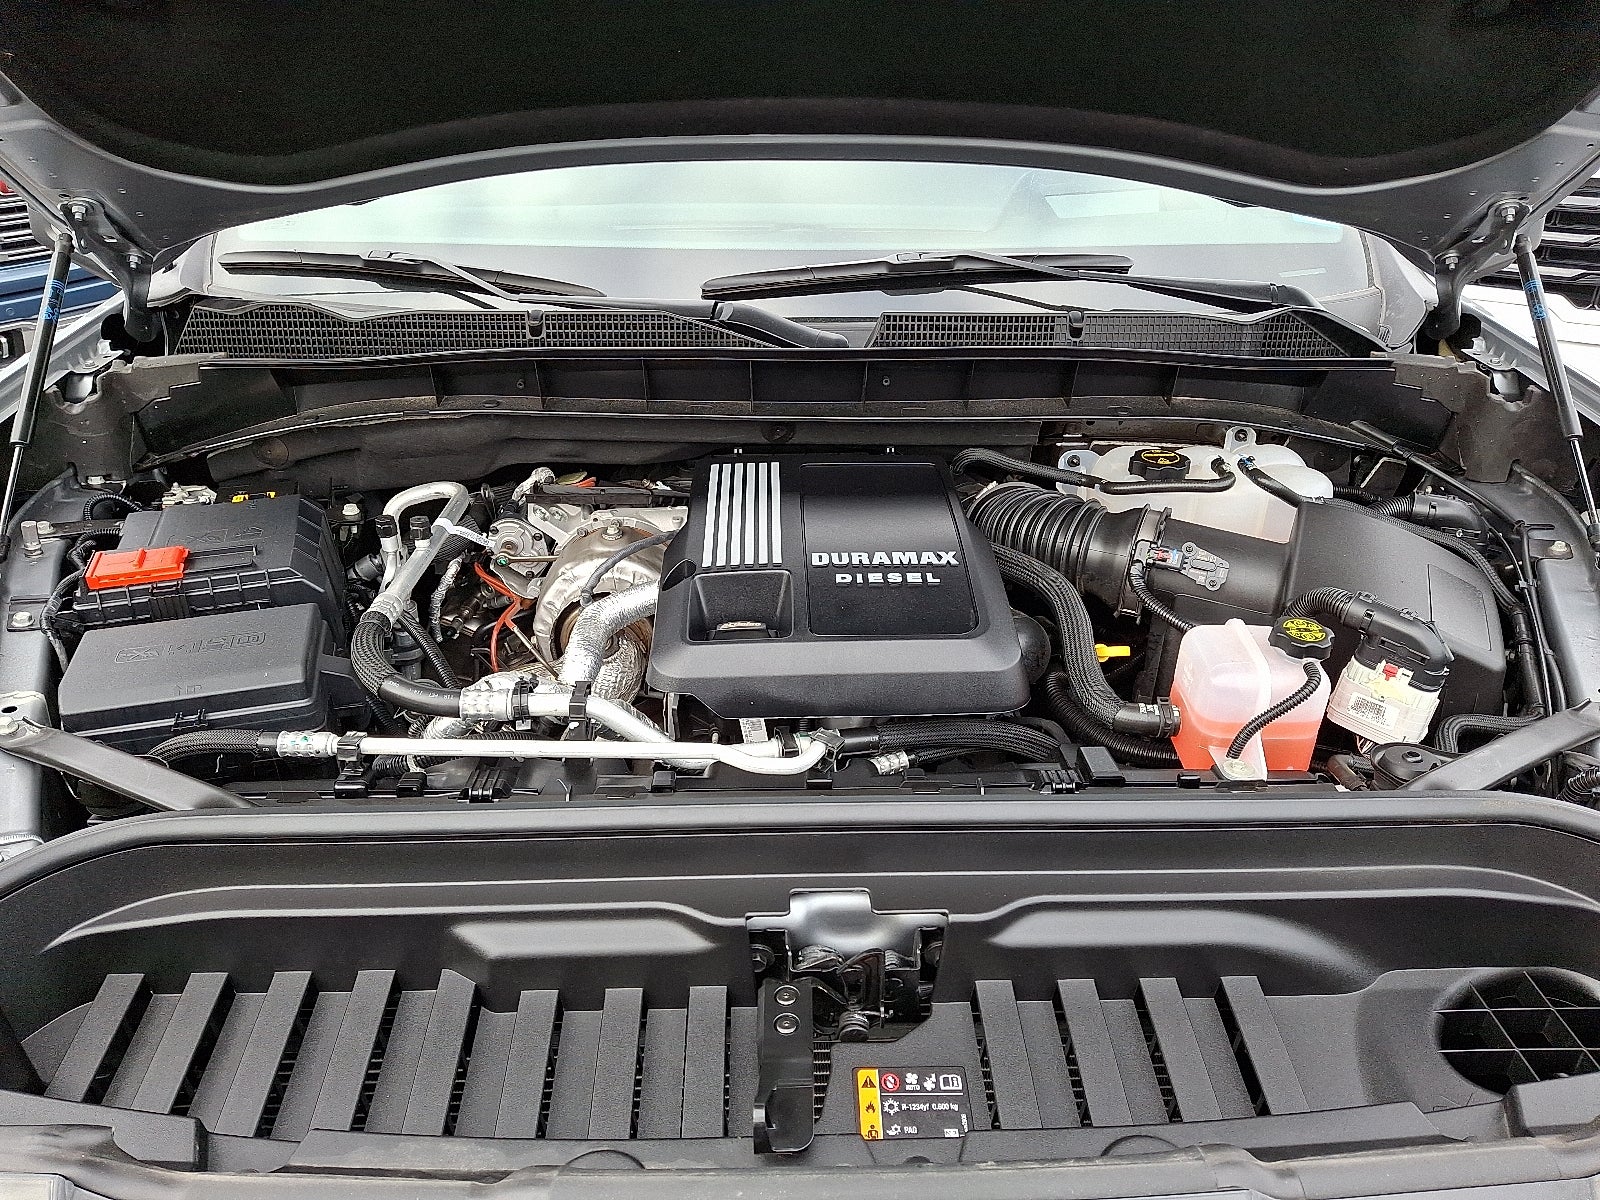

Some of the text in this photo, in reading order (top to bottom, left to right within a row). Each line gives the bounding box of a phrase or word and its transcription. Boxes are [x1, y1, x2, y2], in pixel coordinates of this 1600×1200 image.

[811, 551, 960, 567] DURAMAX
[835, 572, 941, 585] DIESEL
[950, 1103, 959, 1112] kg
